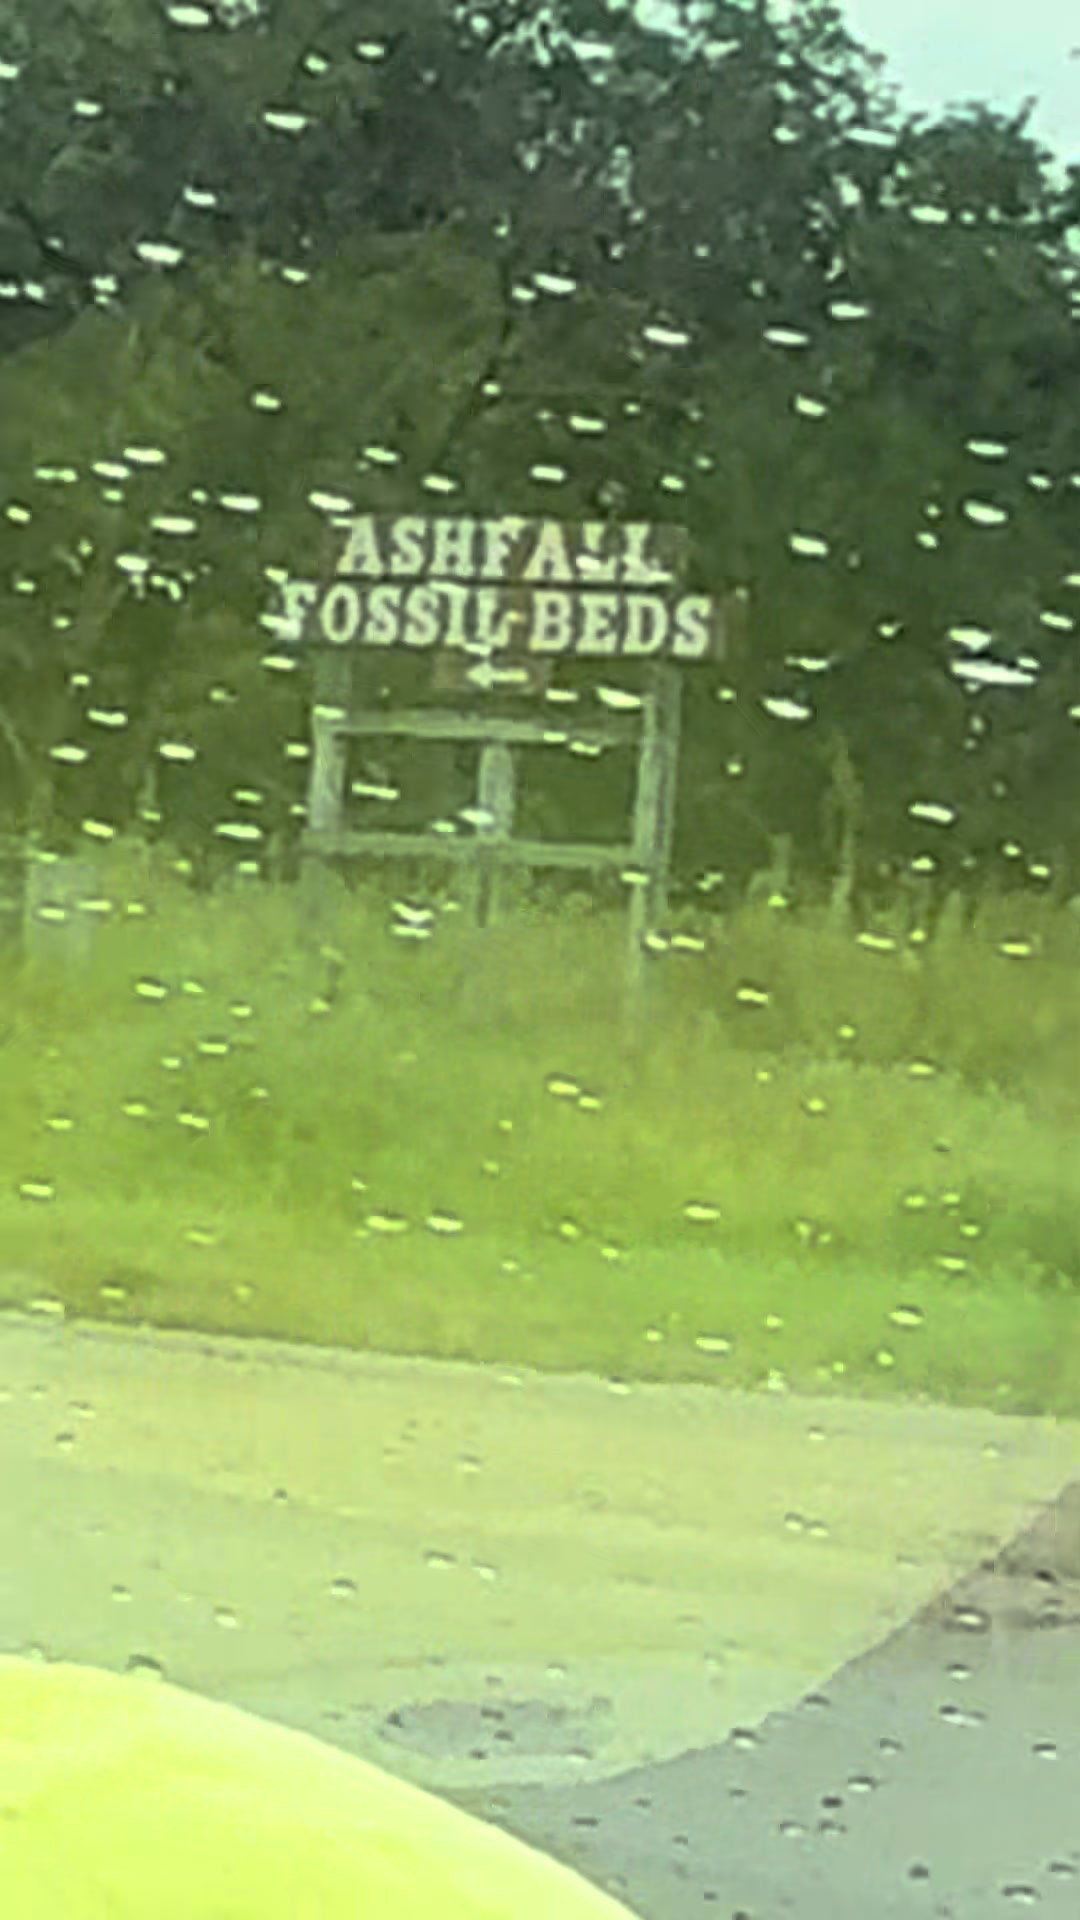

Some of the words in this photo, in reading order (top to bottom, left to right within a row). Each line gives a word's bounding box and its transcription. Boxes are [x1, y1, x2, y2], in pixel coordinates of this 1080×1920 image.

[336, 516, 664, 582] ASHFALL
[282, 583, 510, 646] FOSSIL
[529, 590, 712, 656] BEDS
